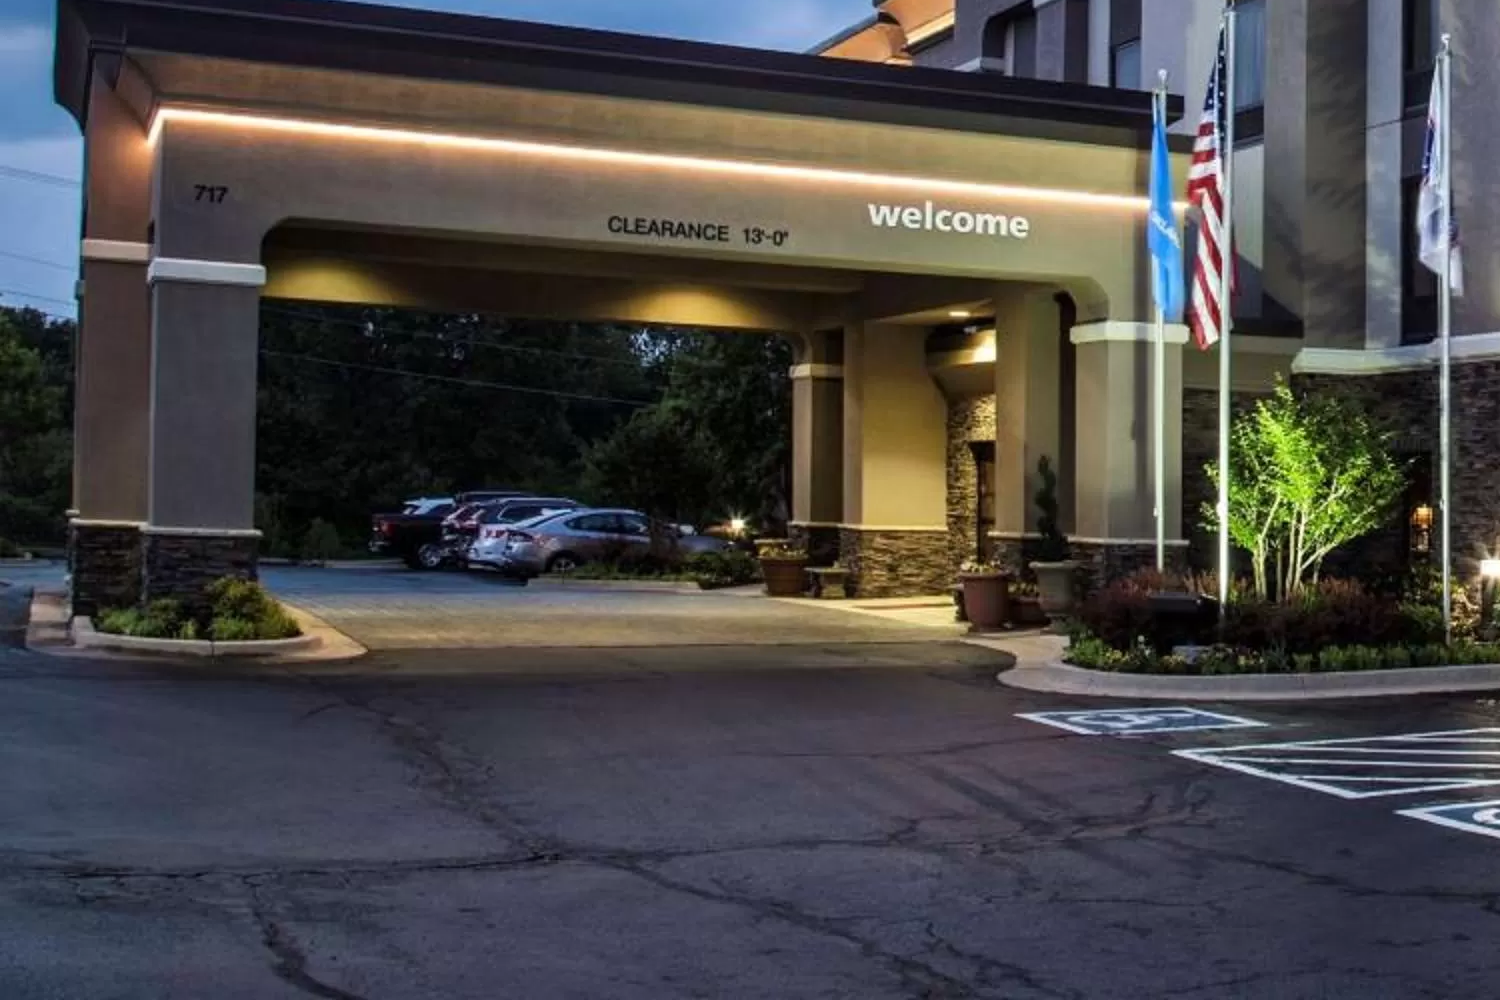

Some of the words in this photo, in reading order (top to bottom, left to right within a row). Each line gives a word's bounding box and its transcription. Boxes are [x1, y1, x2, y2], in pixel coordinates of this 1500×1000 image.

[193, 184, 229, 204] 717
[607, 215, 731, 242] CLEARANCE
[867, 200, 1030, 239] welcome
